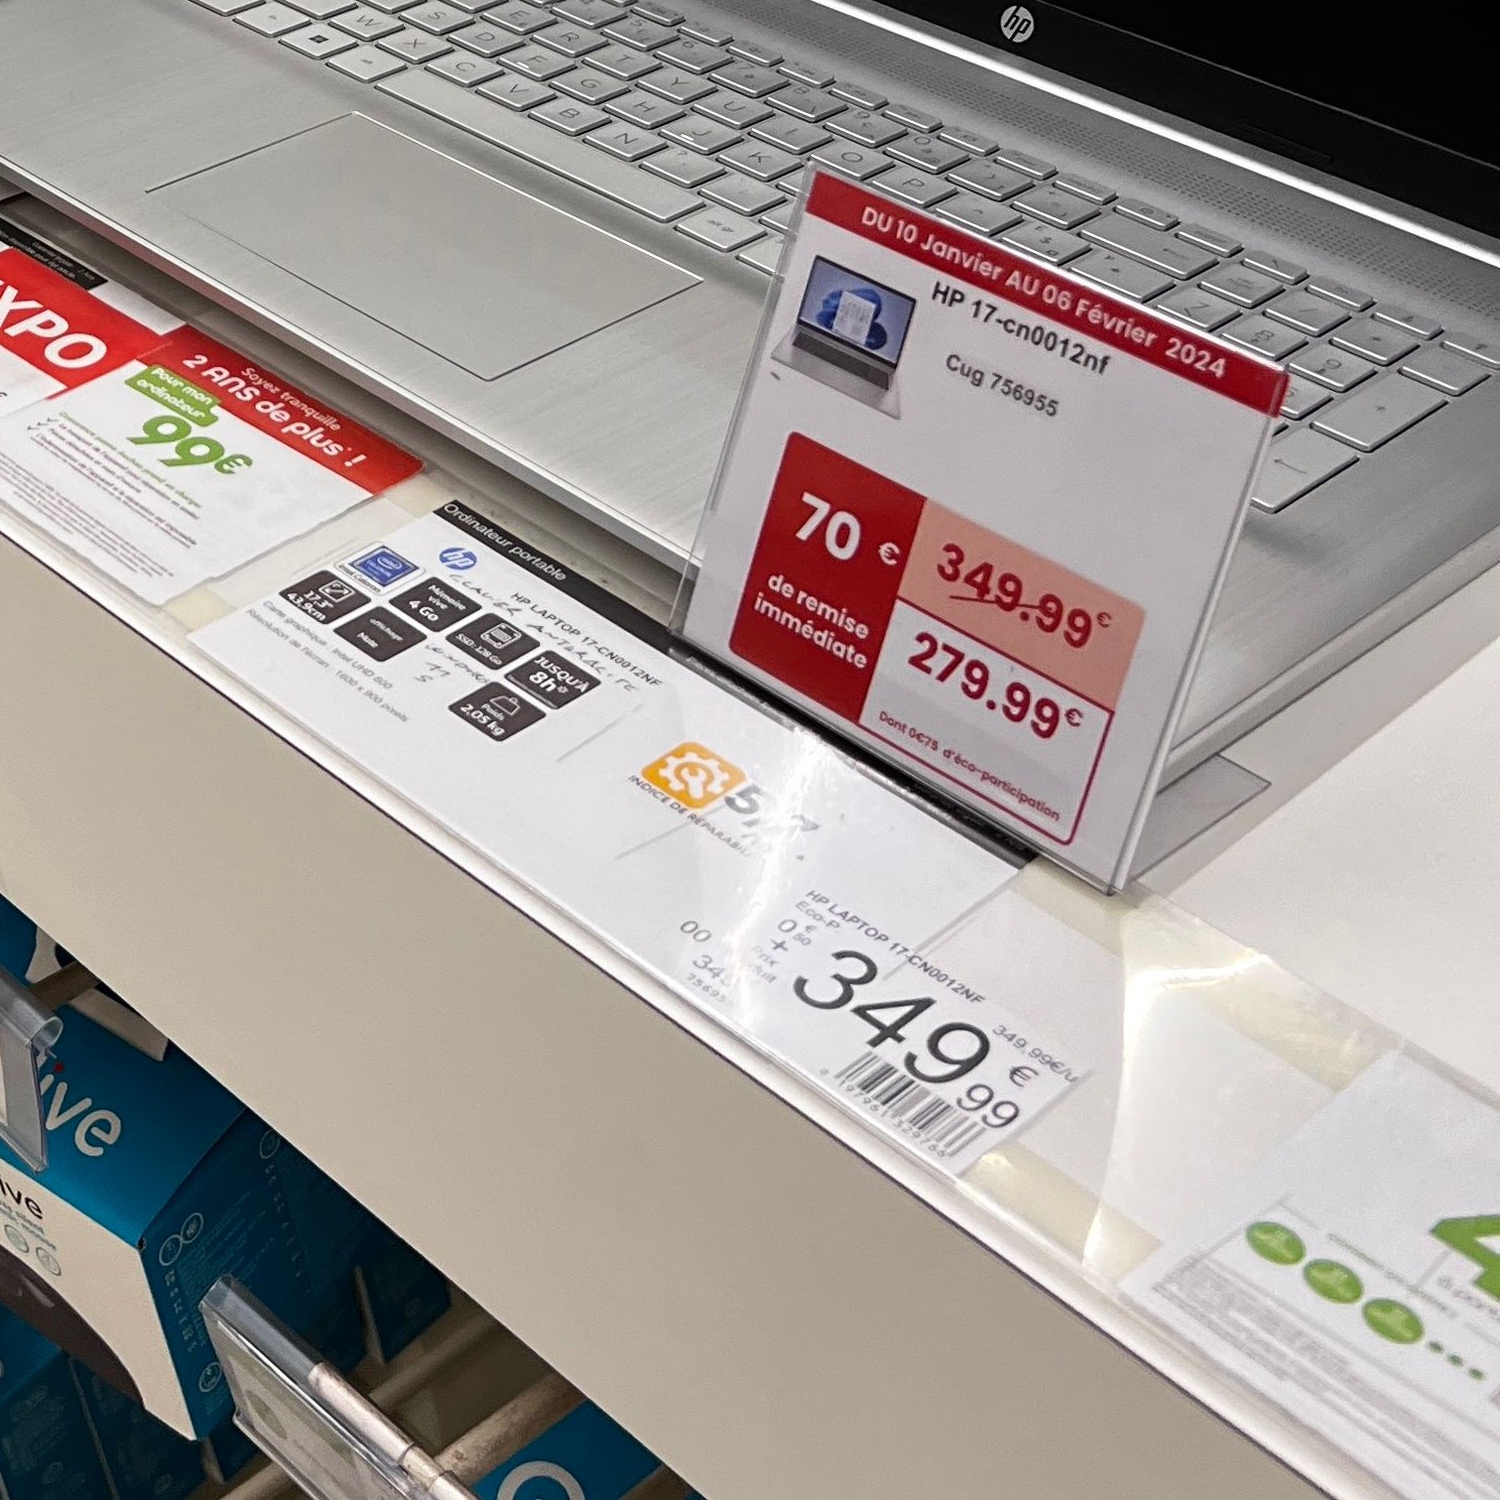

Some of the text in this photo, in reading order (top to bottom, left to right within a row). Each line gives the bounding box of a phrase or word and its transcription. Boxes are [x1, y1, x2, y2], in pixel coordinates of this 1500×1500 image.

[1000, 5, 1035, 43] hp
[861, 206, 1228, 380] DU 10 Janvier AU 06 Février 2024
[932, 280, 1113, 376] HP 17-cn0012nf
[135, 378, 206, 420] ordinateur
[150, 366, 213, 407] Pour mon
[240, 367, 341, 432] Soyez tranquille
[945, 352, 1060, 419] Cug 756955
[125, 414, 254, 476] 99€
[443, 503, 568, 582] Ordinateur portable
[795, 490, 901, 567] 70 €
[408, 598, 440, 622] 4 Go
[427, 584, 468, 611] Mémoire
[753, 591, 869, 671] immédiate
[767, 572, 871, 641] de remise
[510, 591, 665, 688] HP LAPTOP 17-CN0012NF
[907, 630, 1085, 740] 279.99€
[878, 708, 907, 735] Dont
[941, 745, 1061, 822] d'éco-participation
[679, 919, 712, 944] 00
[804, 888, 988, 1006] HP LAPTOP 17-CN0012NF
[792, 947, 992, 1085] 349
[955, 1082, 1021, 1130] 99
[1007, 1065, 1041, 1089] €
